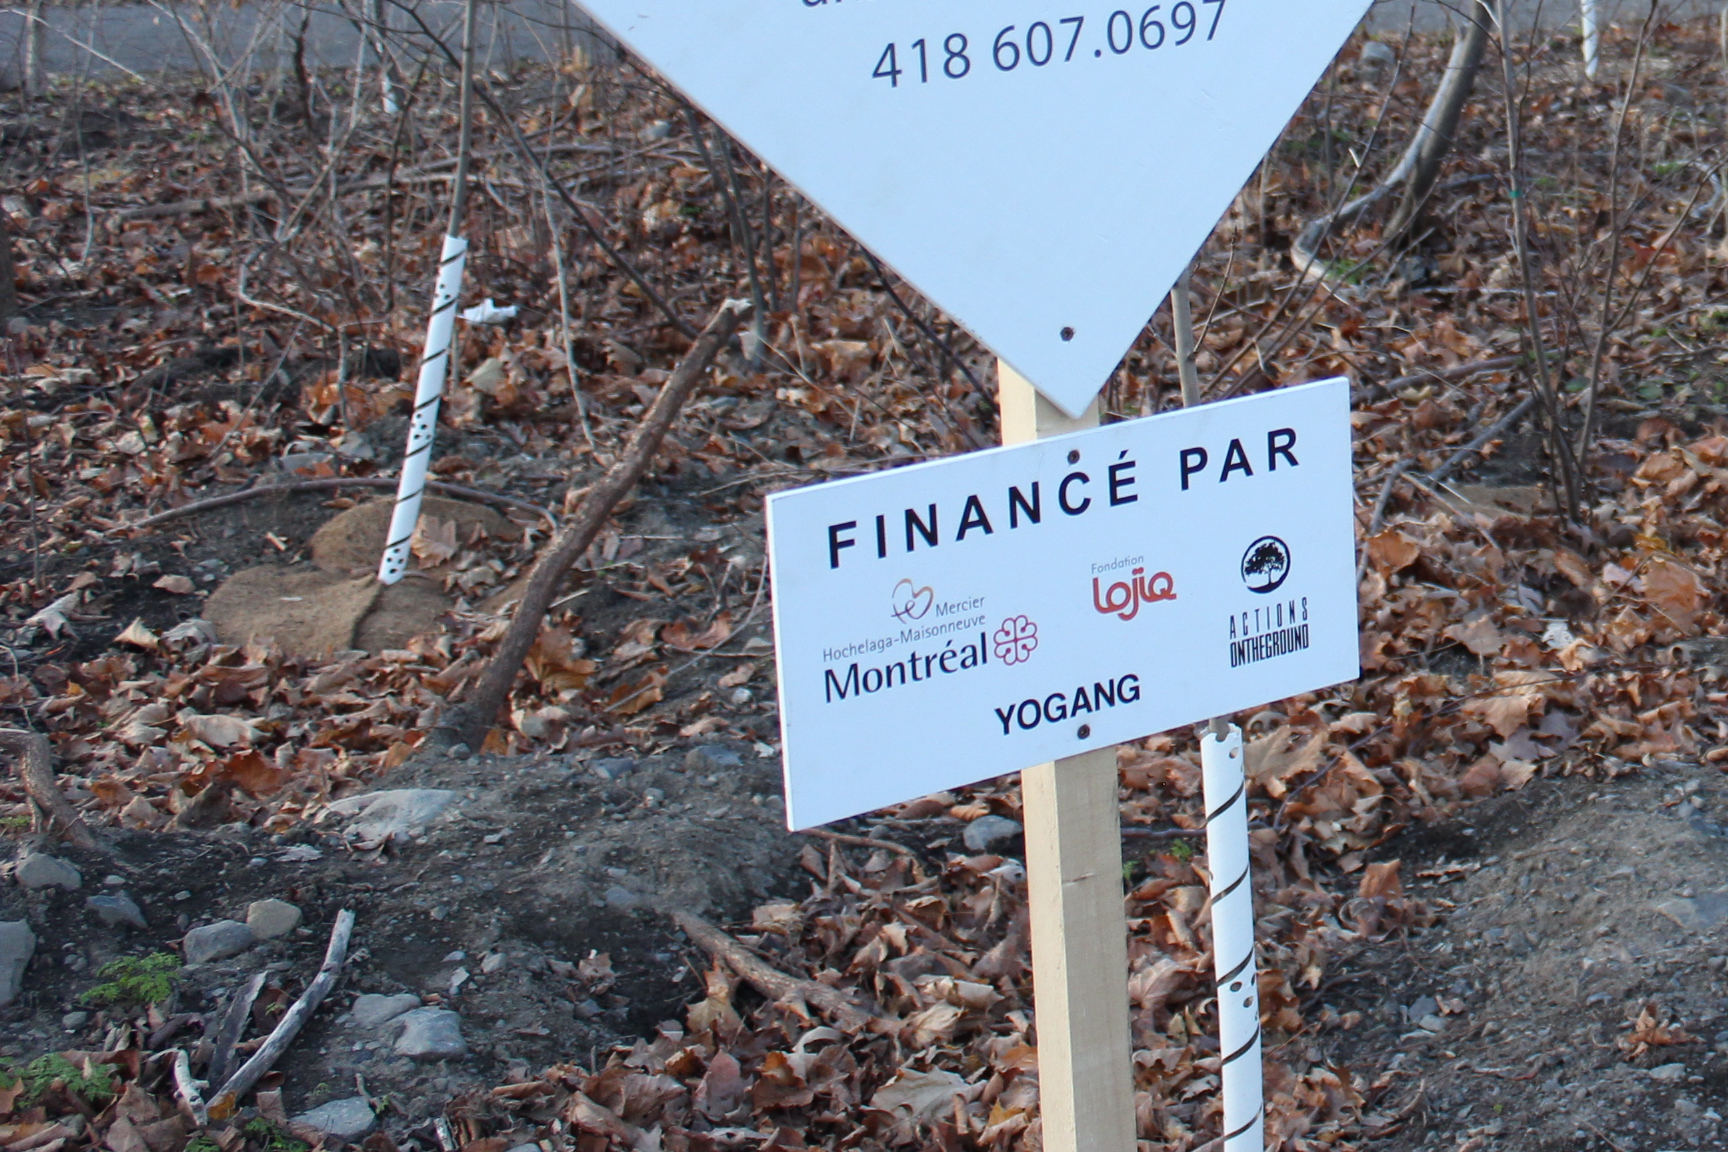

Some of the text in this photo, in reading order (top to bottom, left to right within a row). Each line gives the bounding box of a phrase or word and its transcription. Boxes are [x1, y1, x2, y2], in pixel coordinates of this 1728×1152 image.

[872, 33, 970, 87] 418
[828, 428, 1299, 569] FINANCÉ PAR
[1091, 555, 1144, 575] Fondation
[936, 597, 985, 617] Mercier
[1230, 597, 1307, 640] ACTIONS
[823, 614, 986, 663] Hochelaga-Maisonneuve
[825, 632, 987, 703] Montréal
[994, 674, 1140, 735] YOGANG
